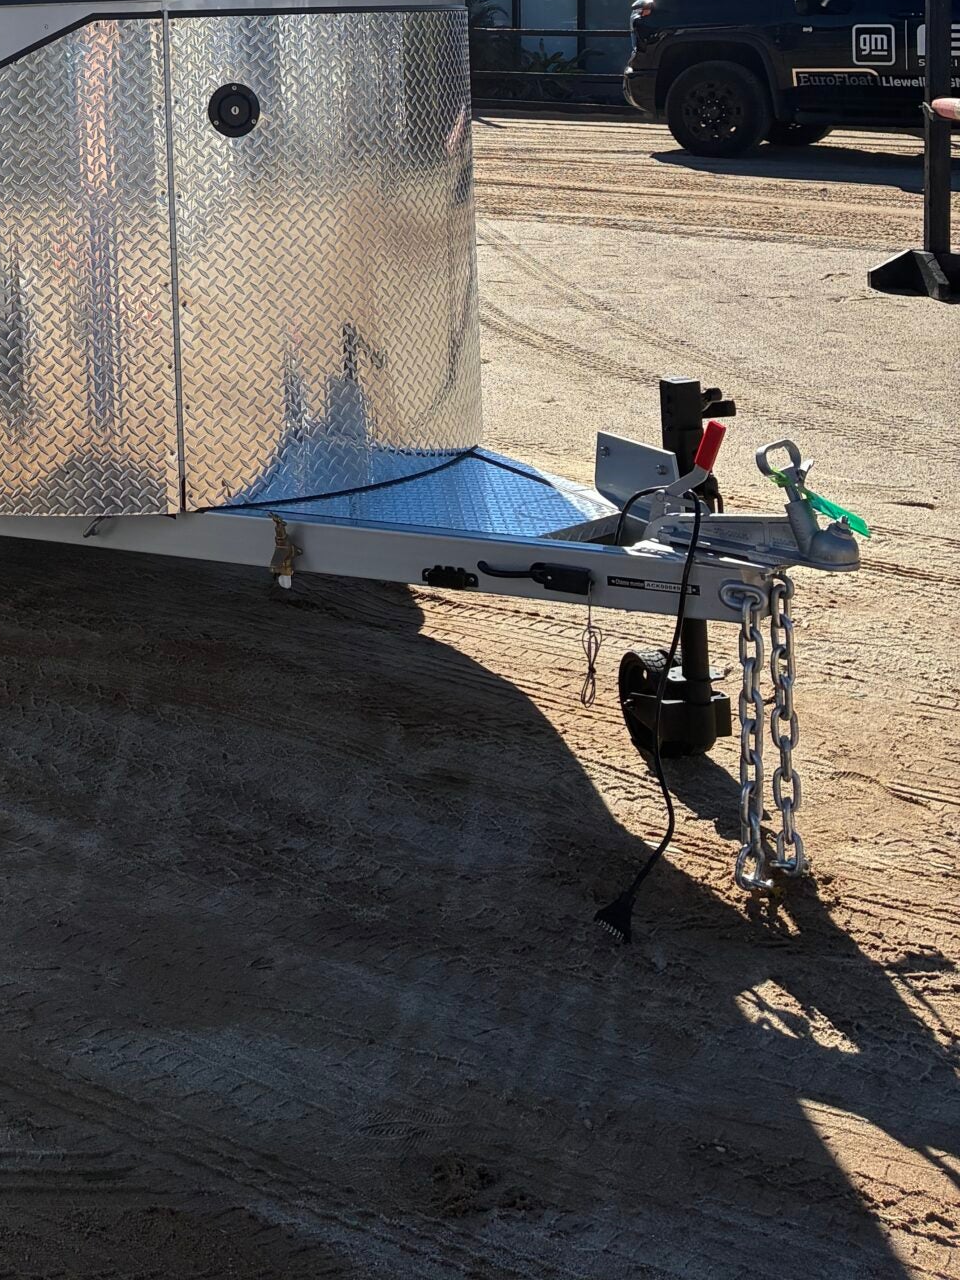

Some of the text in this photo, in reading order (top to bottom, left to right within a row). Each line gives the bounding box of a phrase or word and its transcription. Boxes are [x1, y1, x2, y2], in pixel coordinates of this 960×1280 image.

[859, 34, 888, 55] gm
[798, 74, 926, 87] EuroFloat Llewell
